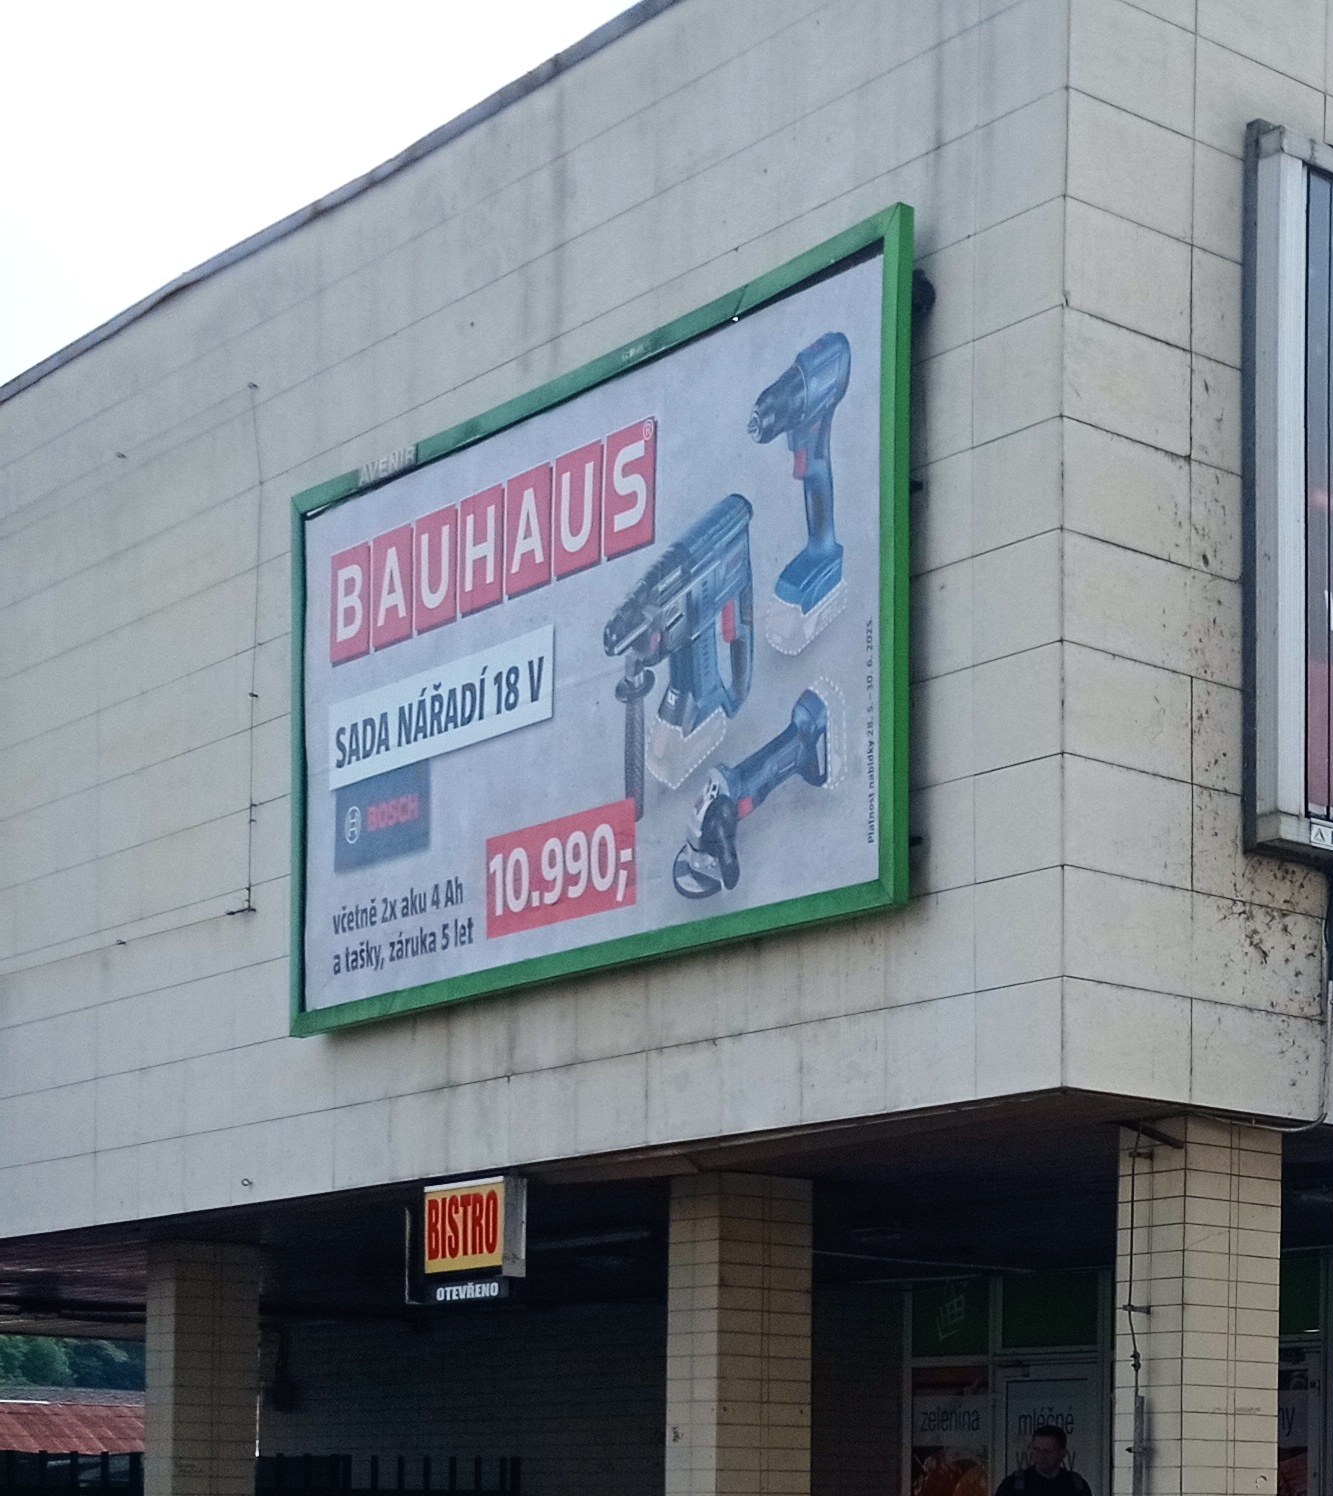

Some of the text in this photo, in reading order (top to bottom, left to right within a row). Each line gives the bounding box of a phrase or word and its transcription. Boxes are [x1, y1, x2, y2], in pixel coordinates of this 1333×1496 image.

[358, 445, 416, 487] AVENIR
[334, 437, 649, 643] BAUHAUS
[335, 659, 545, 769] SADA NÁŘADÍ 18 V
[367, 793, 419, 832] BOSCH
[332, 876, 464, 935] včetně 2x aku 4 Ah
[333, 916, 475, 976] a tašky, záruka 5 let
[427, 1189, 499, 1261] BISTRO
[436, 1282, 499, 1301] OTEVŘENO
